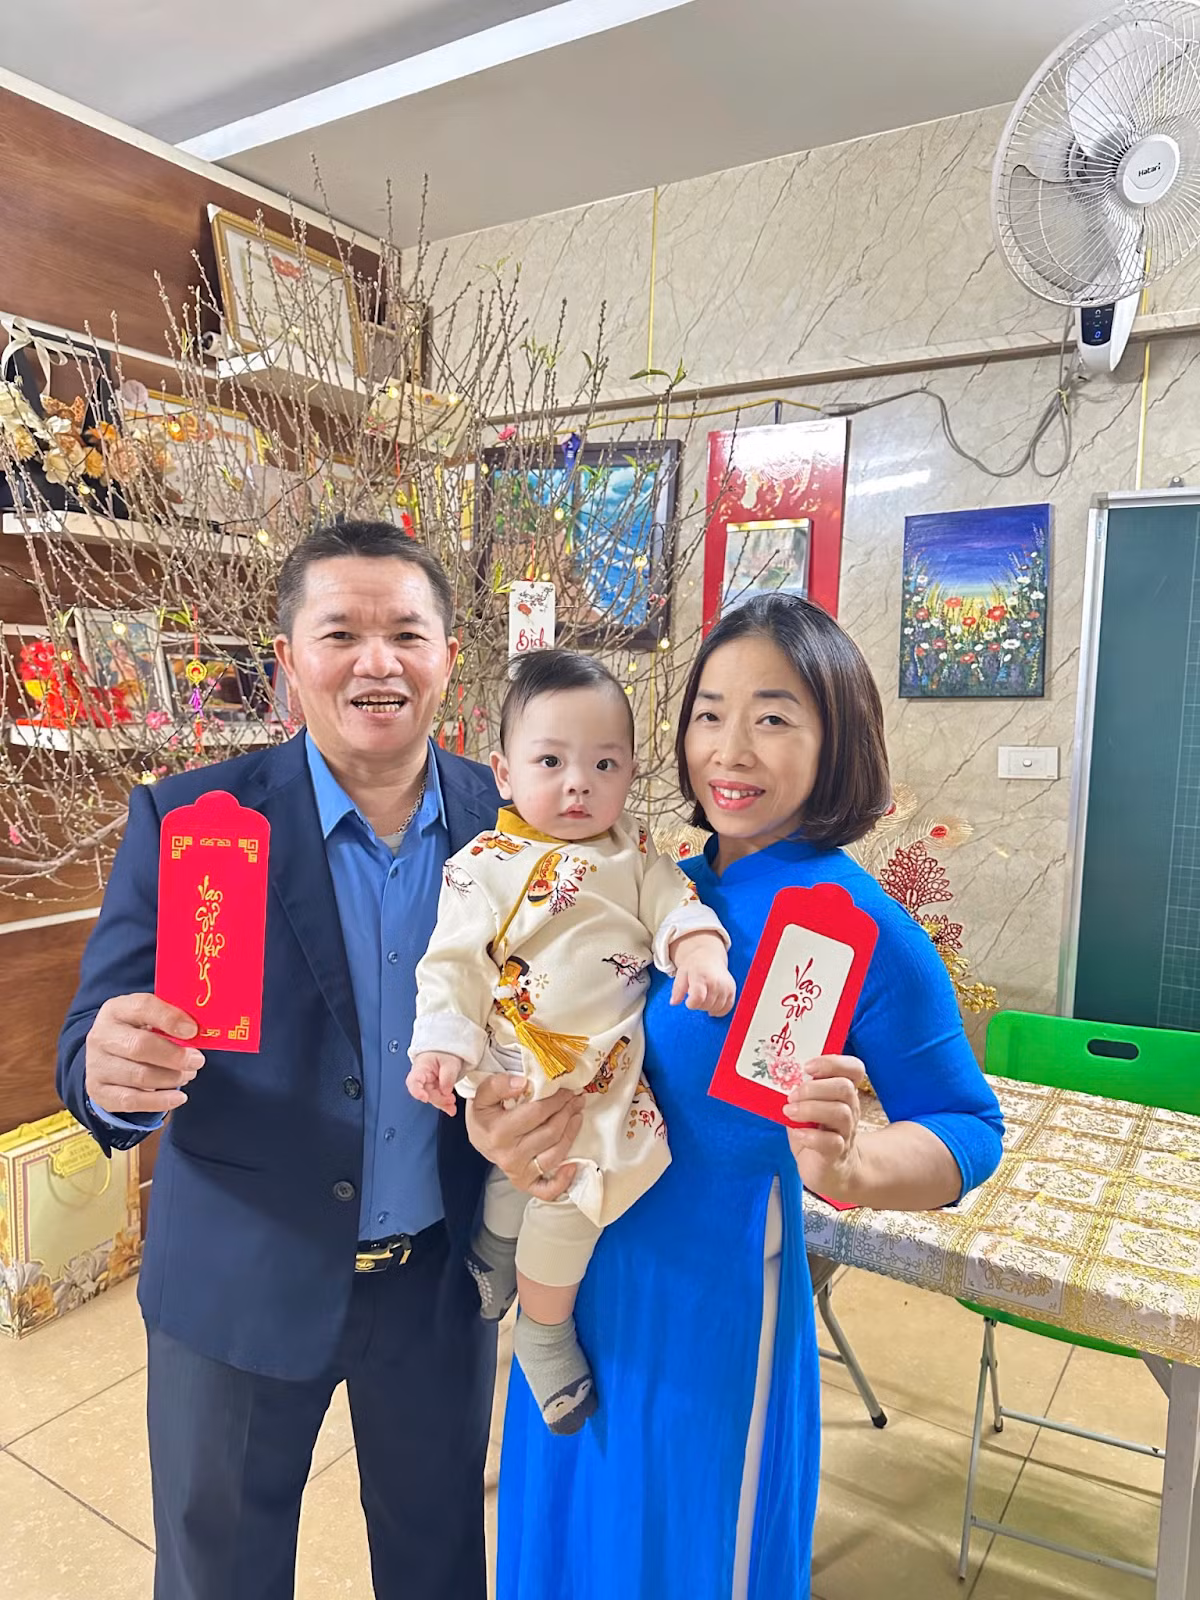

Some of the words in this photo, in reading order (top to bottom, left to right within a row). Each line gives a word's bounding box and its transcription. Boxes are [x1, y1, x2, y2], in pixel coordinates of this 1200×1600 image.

[1138, 162, 1161, 177] Hatari
[195, 902, 221, 933] Sự
[795, 957, 822, 1000] Vạn
[781, 993, 814, 1022] Sự
